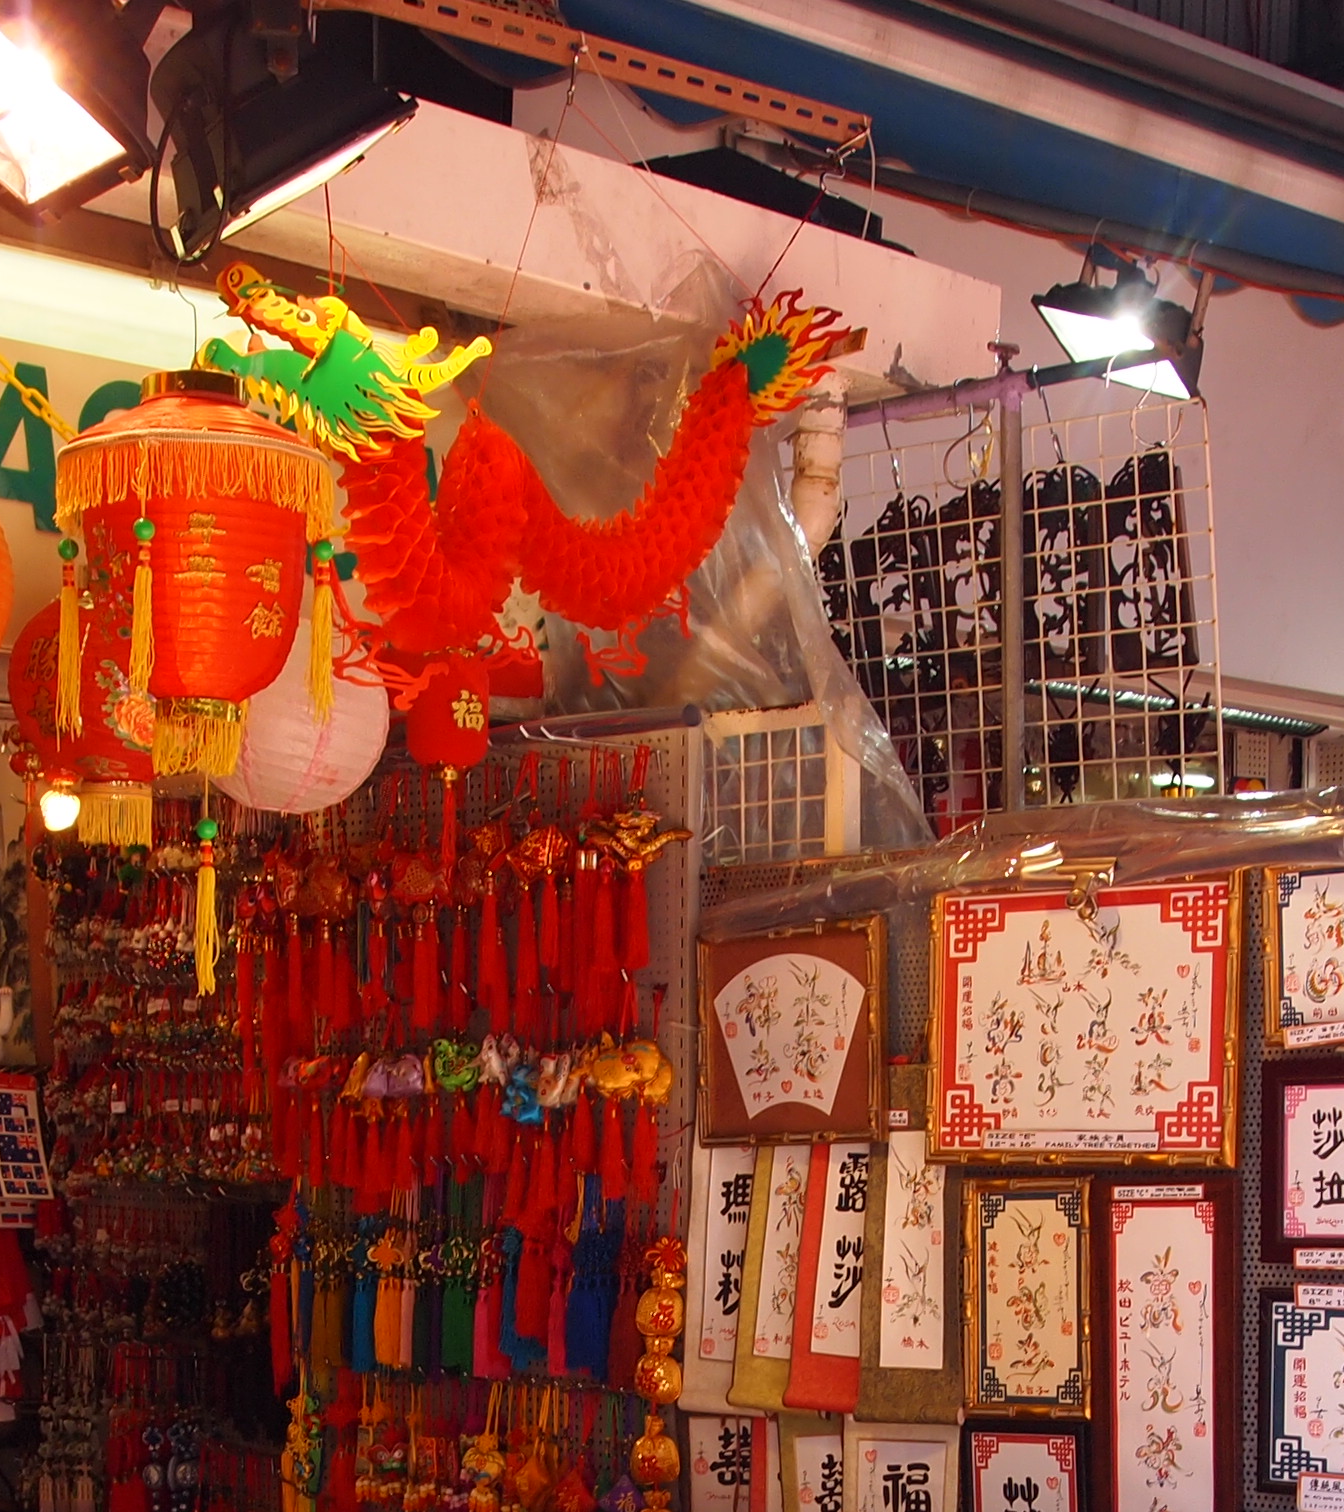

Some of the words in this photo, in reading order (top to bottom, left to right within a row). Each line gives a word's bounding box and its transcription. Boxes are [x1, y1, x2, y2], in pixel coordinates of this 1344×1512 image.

[451, 689, 484, 732] 福
[1109, 1141, 1157, 1149] TOGETHER
[1117, 1189, 1135, 1198] SIZE
[1302, 1288, 1334, 1296] SIZE
[1117, 1279, 1134, 1402] 秋田ビューホテル
